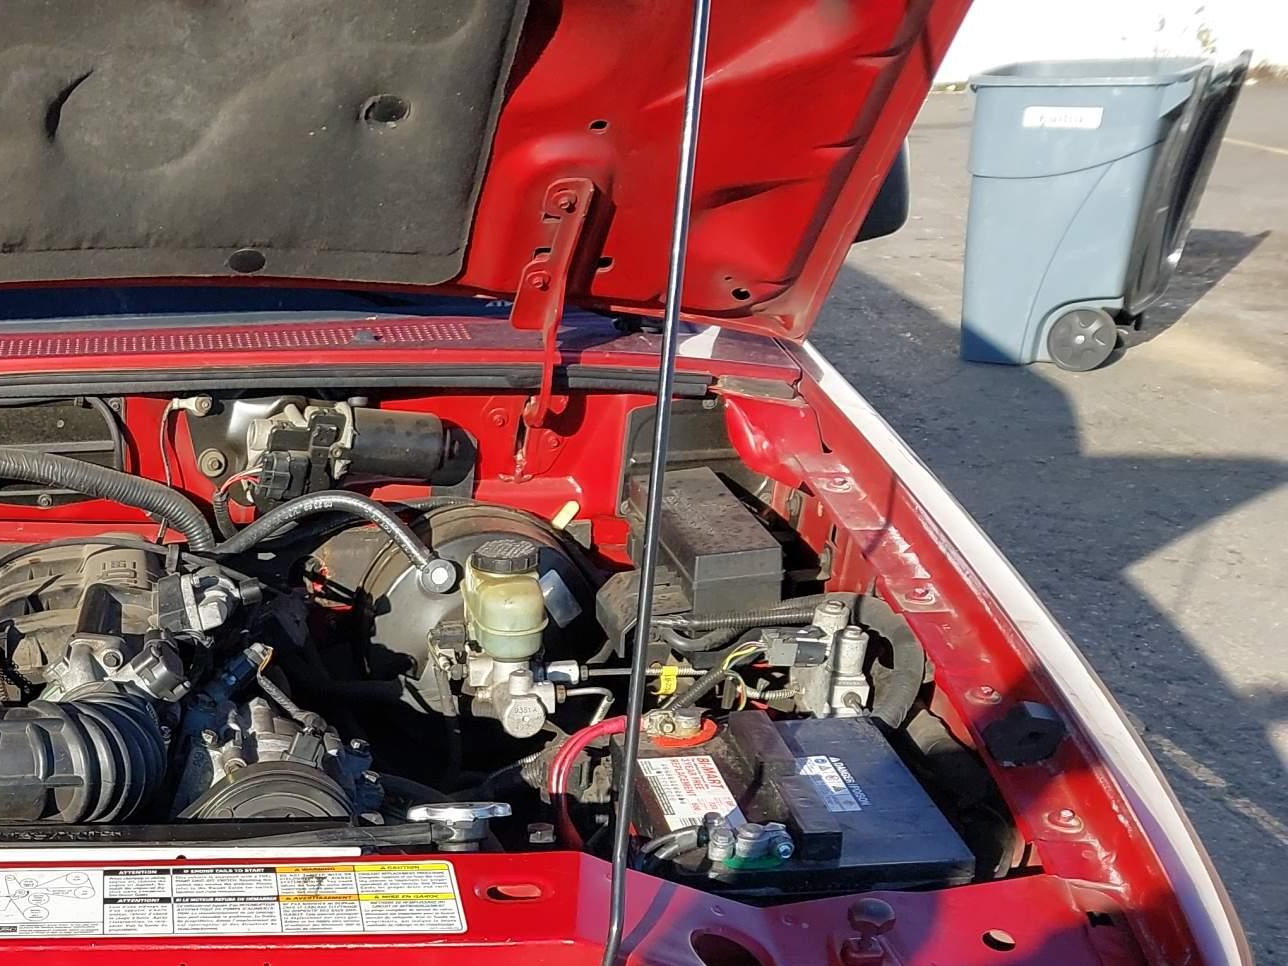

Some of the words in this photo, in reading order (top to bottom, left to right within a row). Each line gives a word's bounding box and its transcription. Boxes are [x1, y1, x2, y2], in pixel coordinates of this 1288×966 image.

[670, 759, 697, 797] REPLACEMENT
[684, 762, 696, 776] YEAR
[692, 776, 706, 791] FREE
[697, 757, 725, 790] BI-MART
